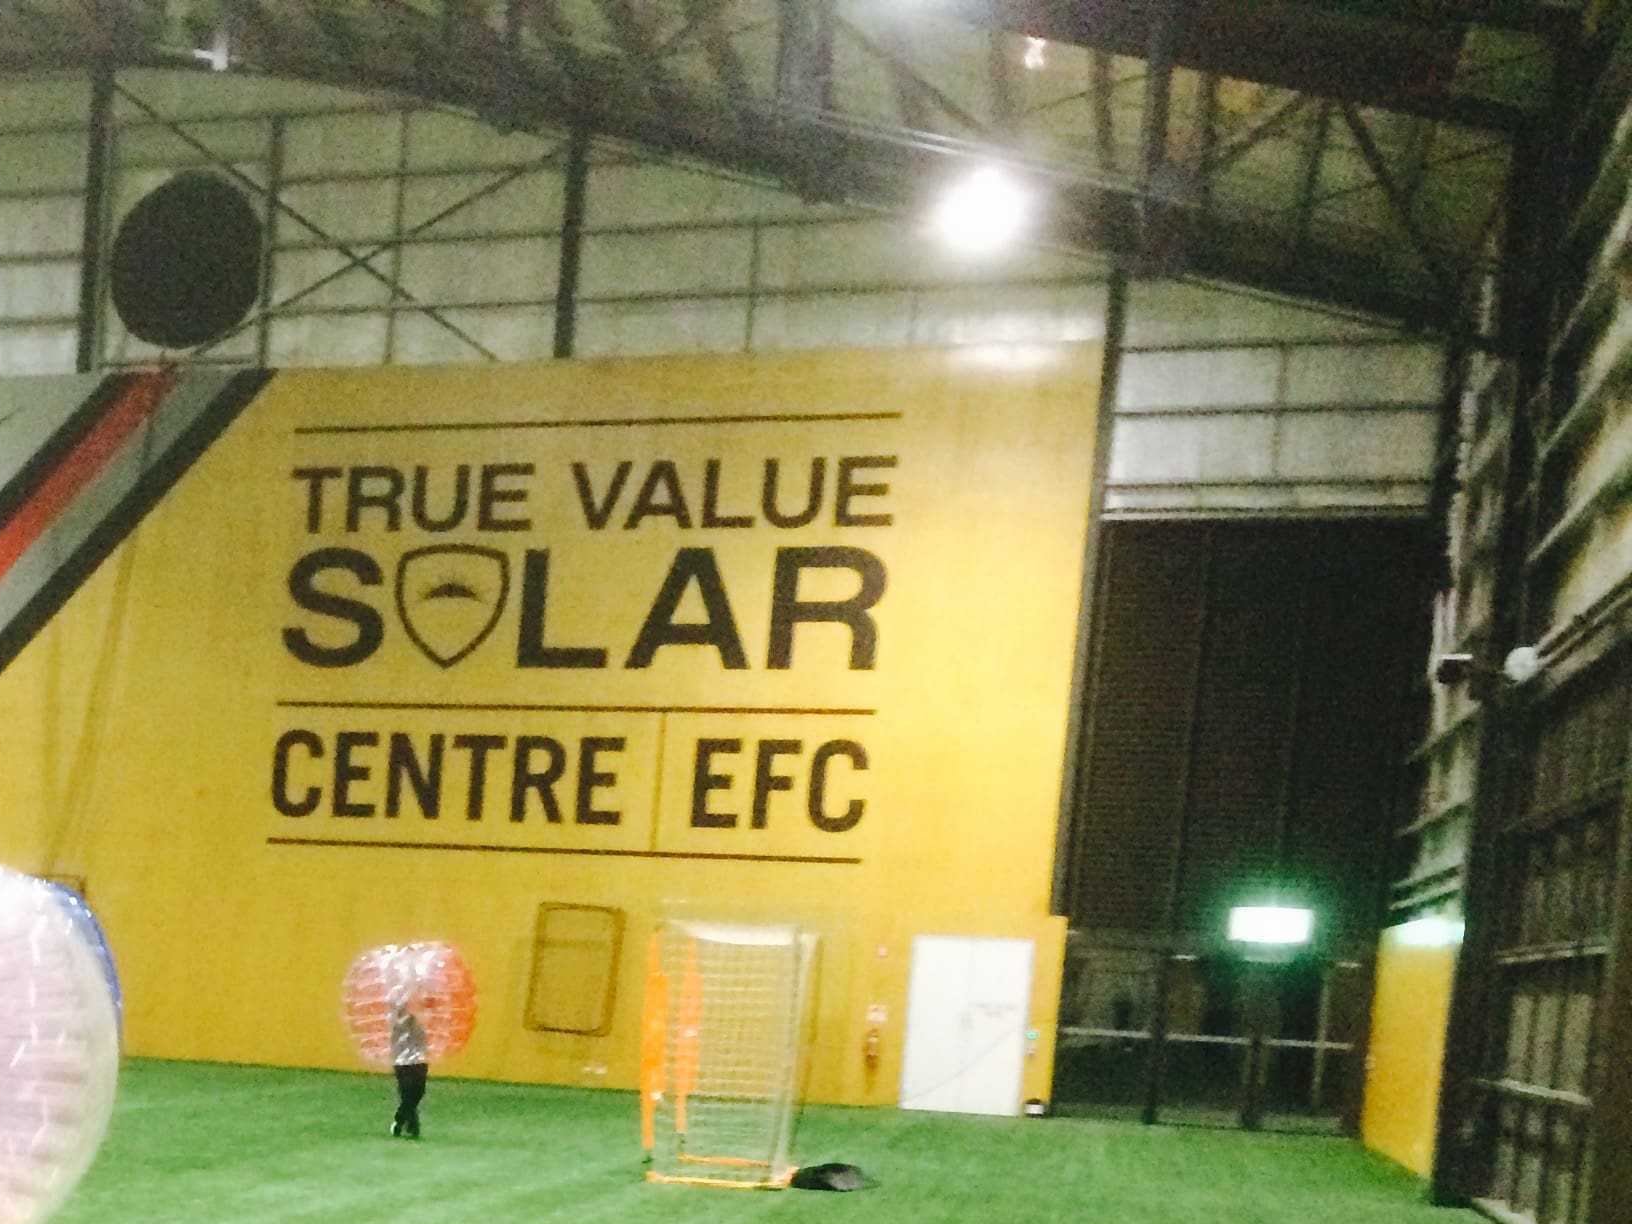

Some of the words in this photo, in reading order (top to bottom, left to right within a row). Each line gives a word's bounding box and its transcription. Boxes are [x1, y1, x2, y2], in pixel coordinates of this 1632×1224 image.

[291, 463, 536, 533] TRUE
[572, 455, 898, 531] VALUE
[281, 543, 888, 670] SOLAR
[271, 729, 626, 825] CENTRE
[690, 737, 870, 833] EFC
